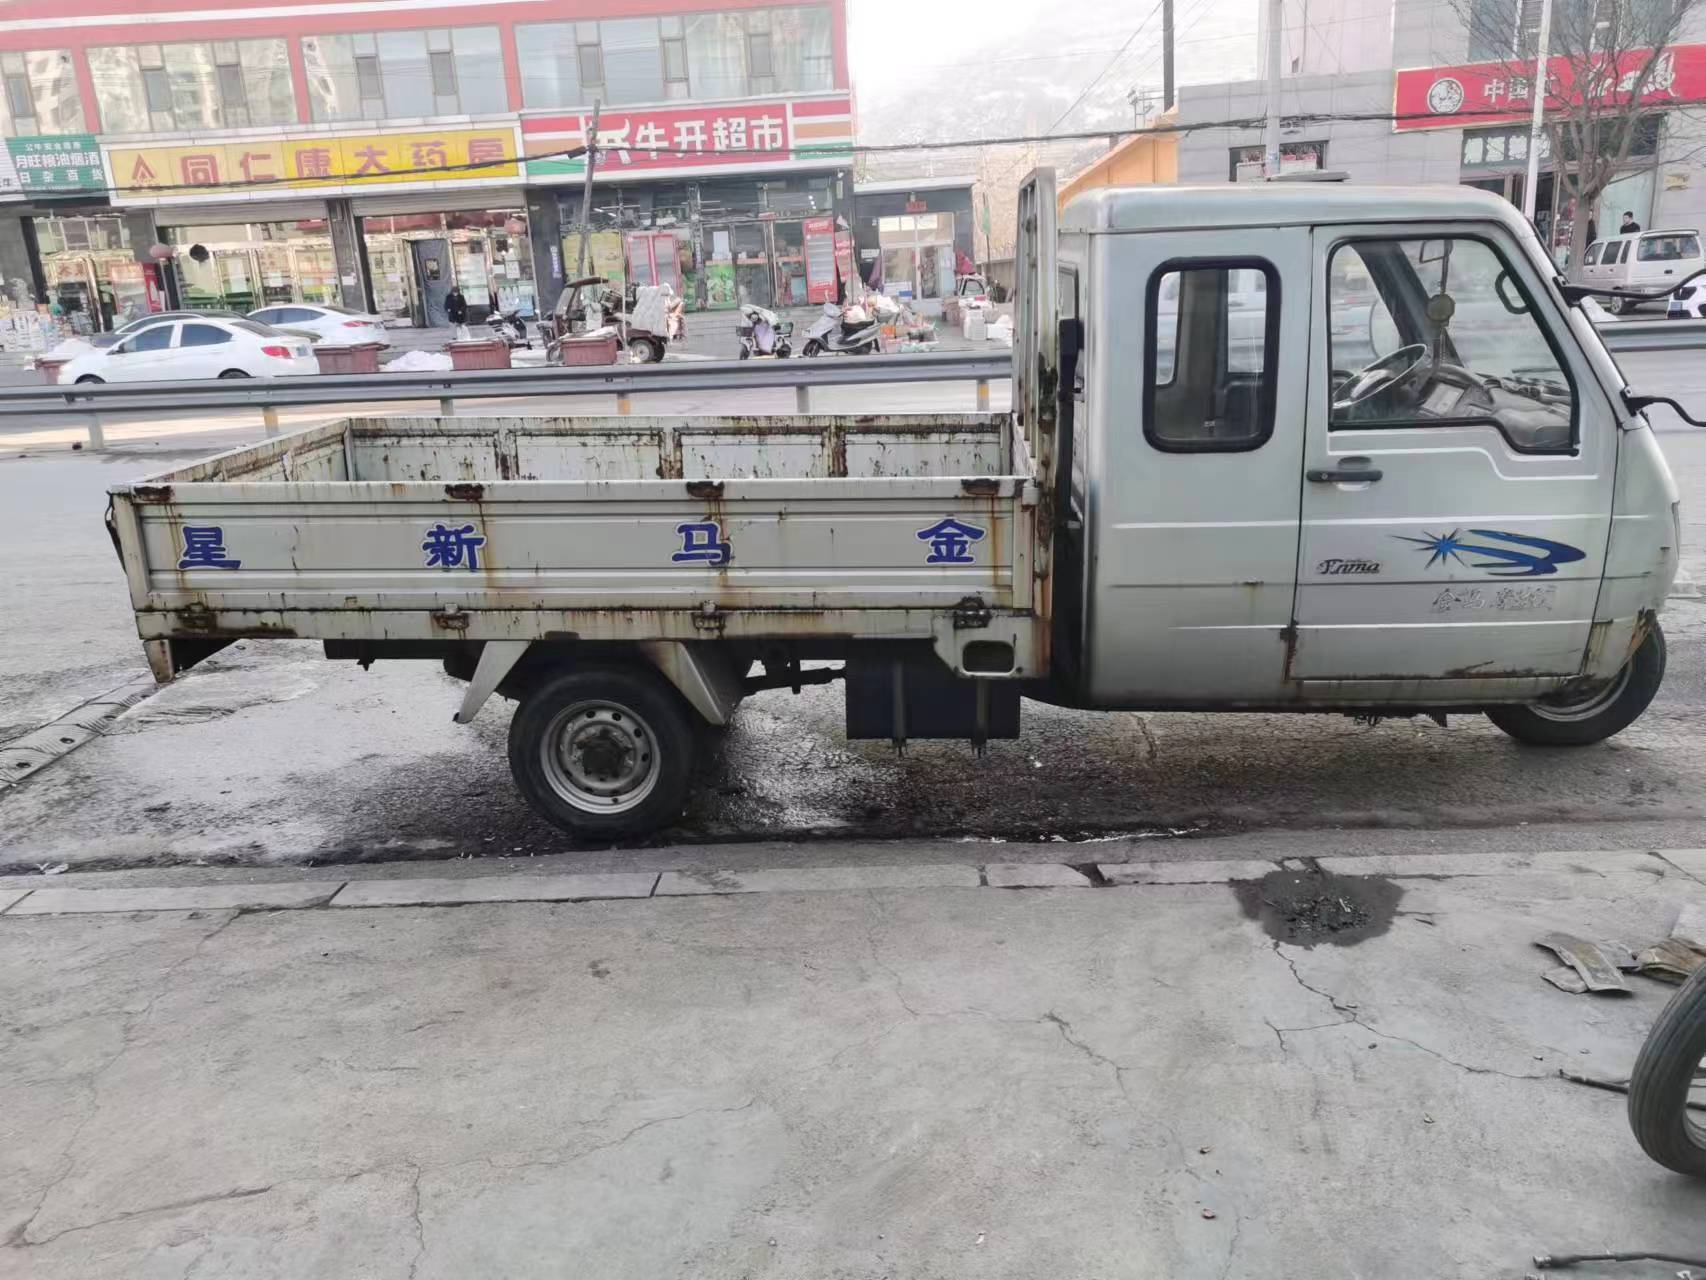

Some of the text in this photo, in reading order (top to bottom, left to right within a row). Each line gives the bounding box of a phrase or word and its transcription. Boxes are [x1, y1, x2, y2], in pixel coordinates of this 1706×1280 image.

[178, 517, 986, 573] 金 马 新 星
